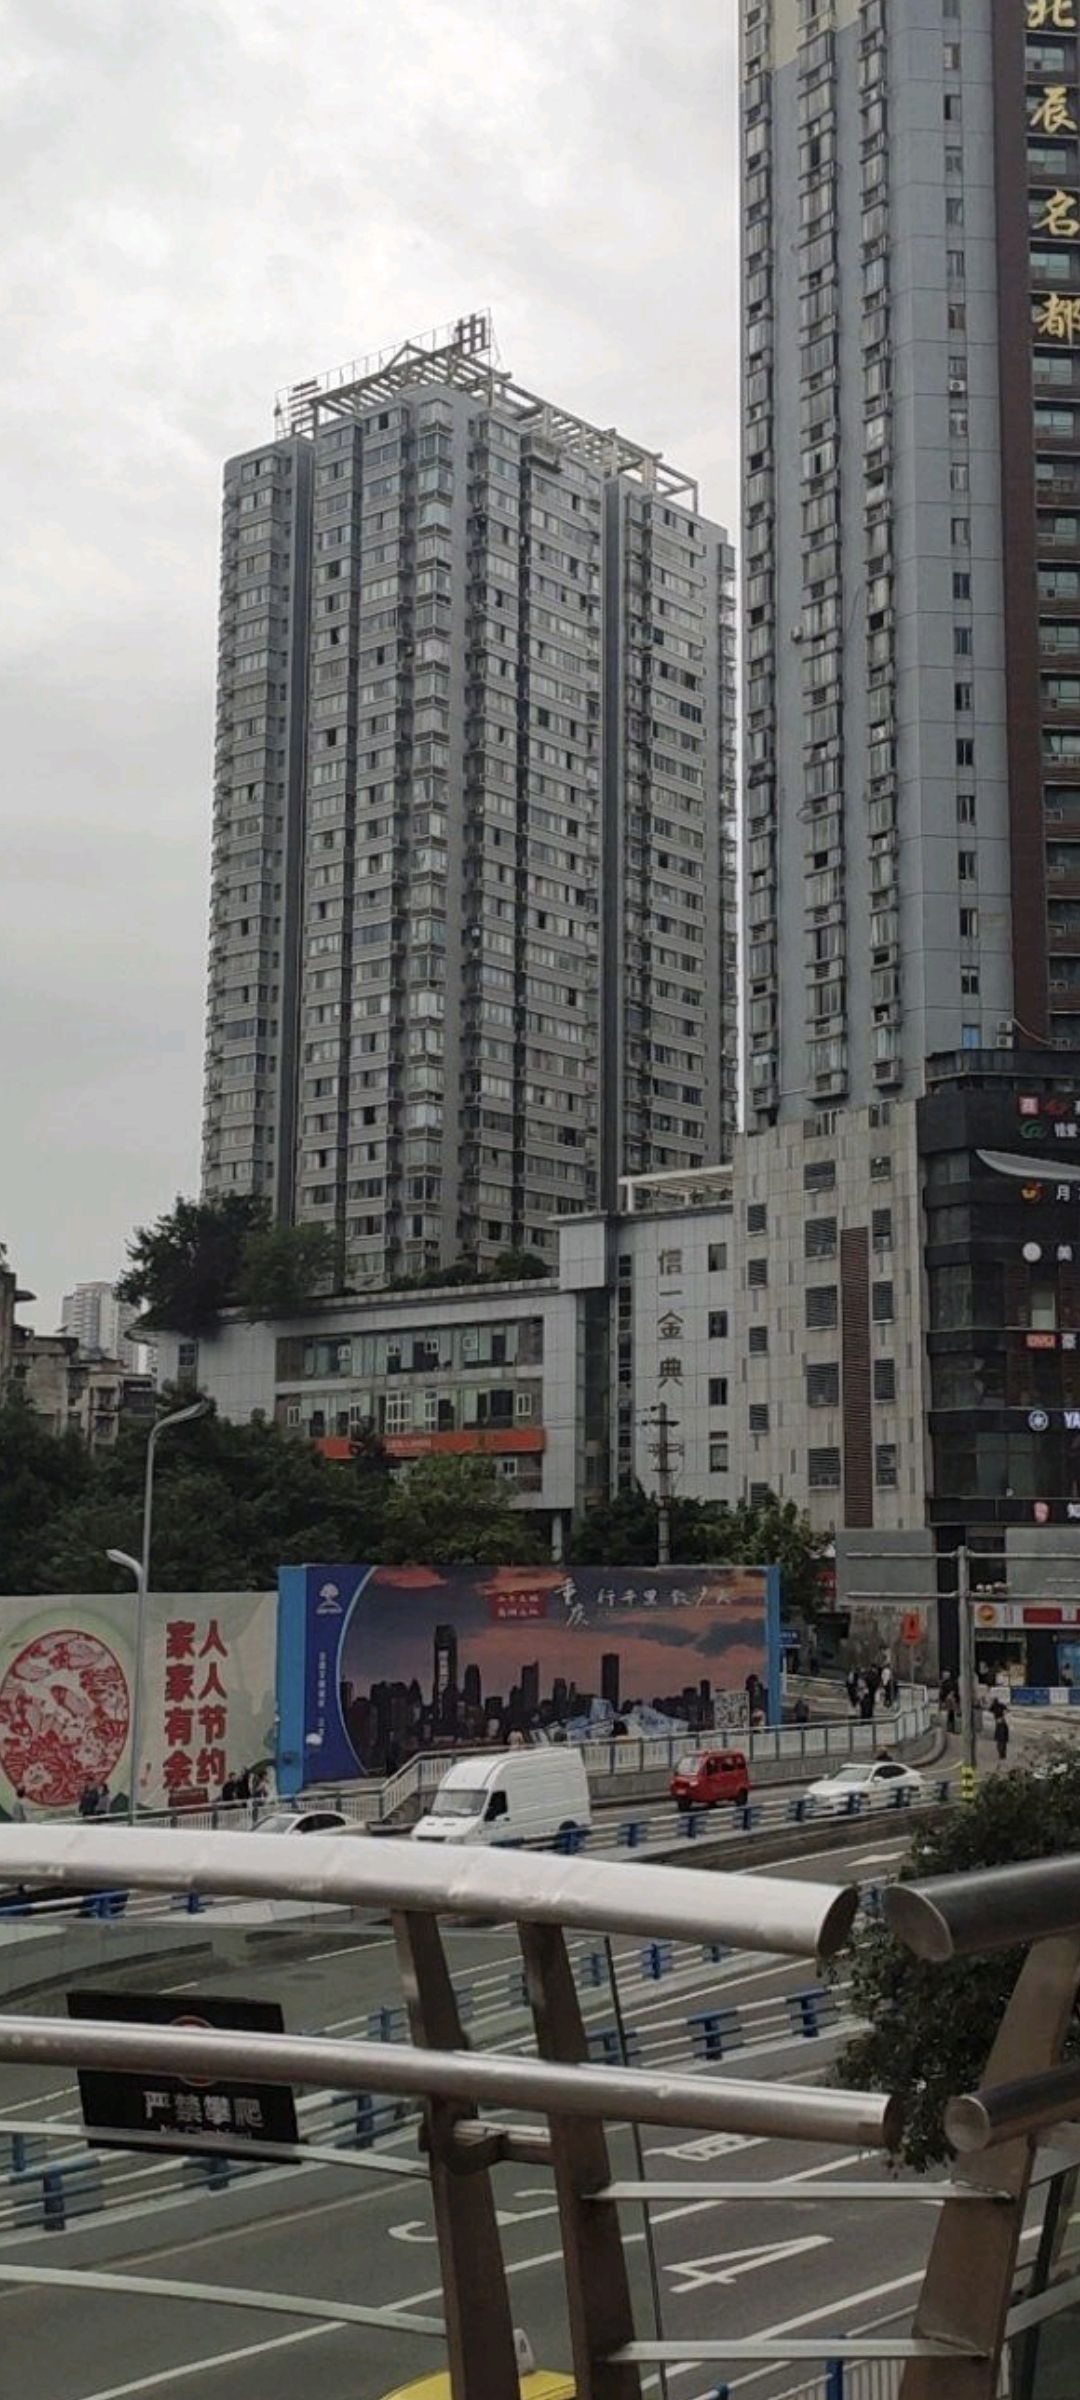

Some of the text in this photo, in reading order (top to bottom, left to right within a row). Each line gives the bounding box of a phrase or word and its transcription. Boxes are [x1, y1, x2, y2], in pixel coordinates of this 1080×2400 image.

[1024, 0, 1080, 345] 北辰名都
[657, 1248, 684, 1390] 信一金典
[554, 1577, 590, 1627] 重庆
[163, 1620, 196, 1789] 家家有余
[196, 1619, 228, 1786] 人人节约
